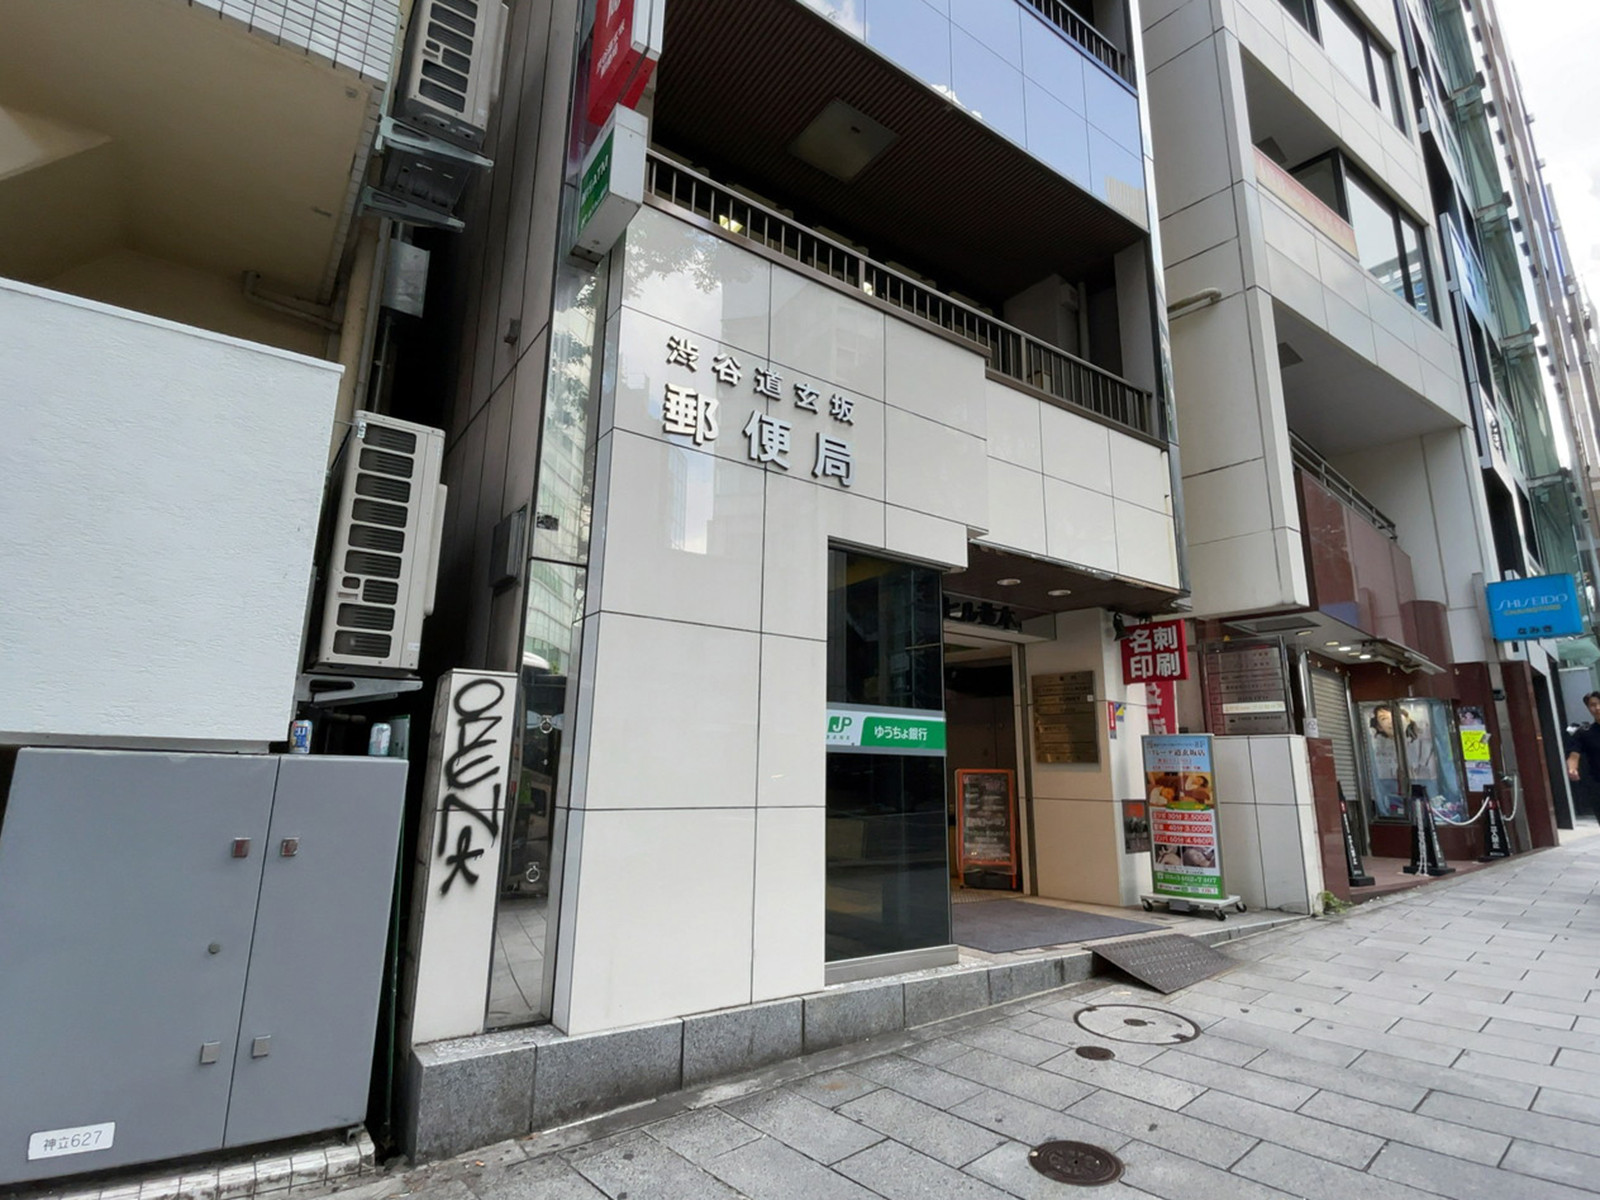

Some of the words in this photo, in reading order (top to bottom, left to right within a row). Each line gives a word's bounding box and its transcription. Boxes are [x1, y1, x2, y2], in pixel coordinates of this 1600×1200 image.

[666, 335, 855, 425] 渋谷道玄坂
[663, 383, 856, 488] 郵便局
[1495, 593, 1569, 611] SHISEIDO
[1129, 625, 1178, 653] 名刺
[1130, 651, 1181, 679] 印刷
[828, 716, 852, 733] JP
[874, 725, 928, 741] ゆうちょ銀行
[43, 1130, 103, 1151] 神立627
